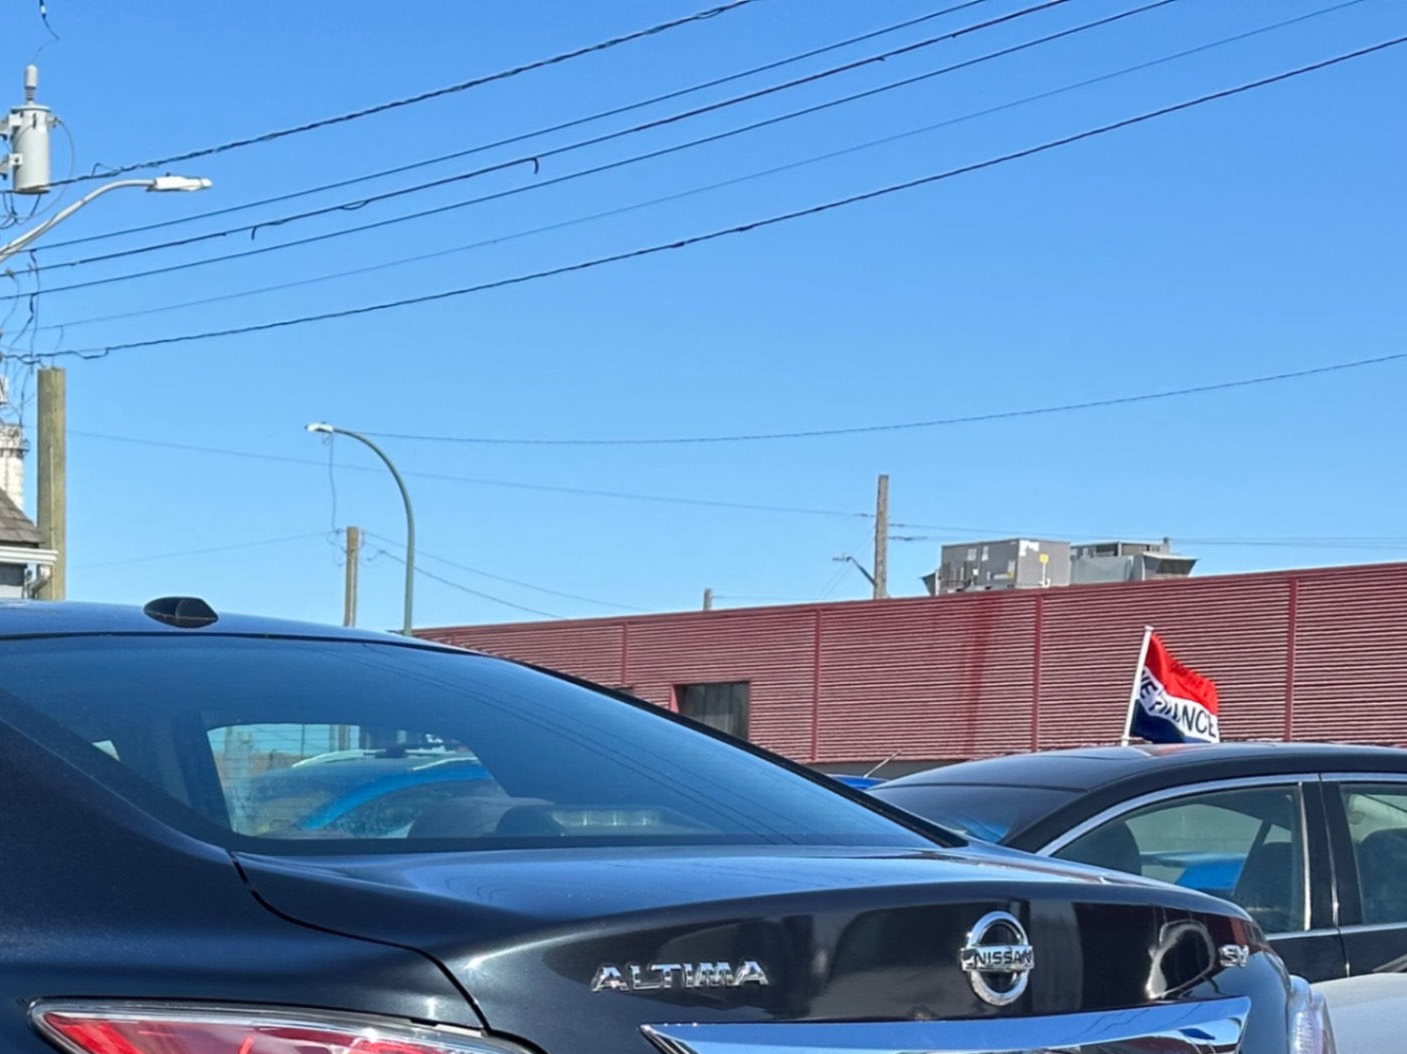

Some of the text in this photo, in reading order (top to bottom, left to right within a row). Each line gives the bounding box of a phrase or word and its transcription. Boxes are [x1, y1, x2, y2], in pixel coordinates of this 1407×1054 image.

[1148, 691, 1217, 738] FINCE
[973, 949, 1033, 966] NISSAN
[591, 960, 769, 992] ALTIMA
